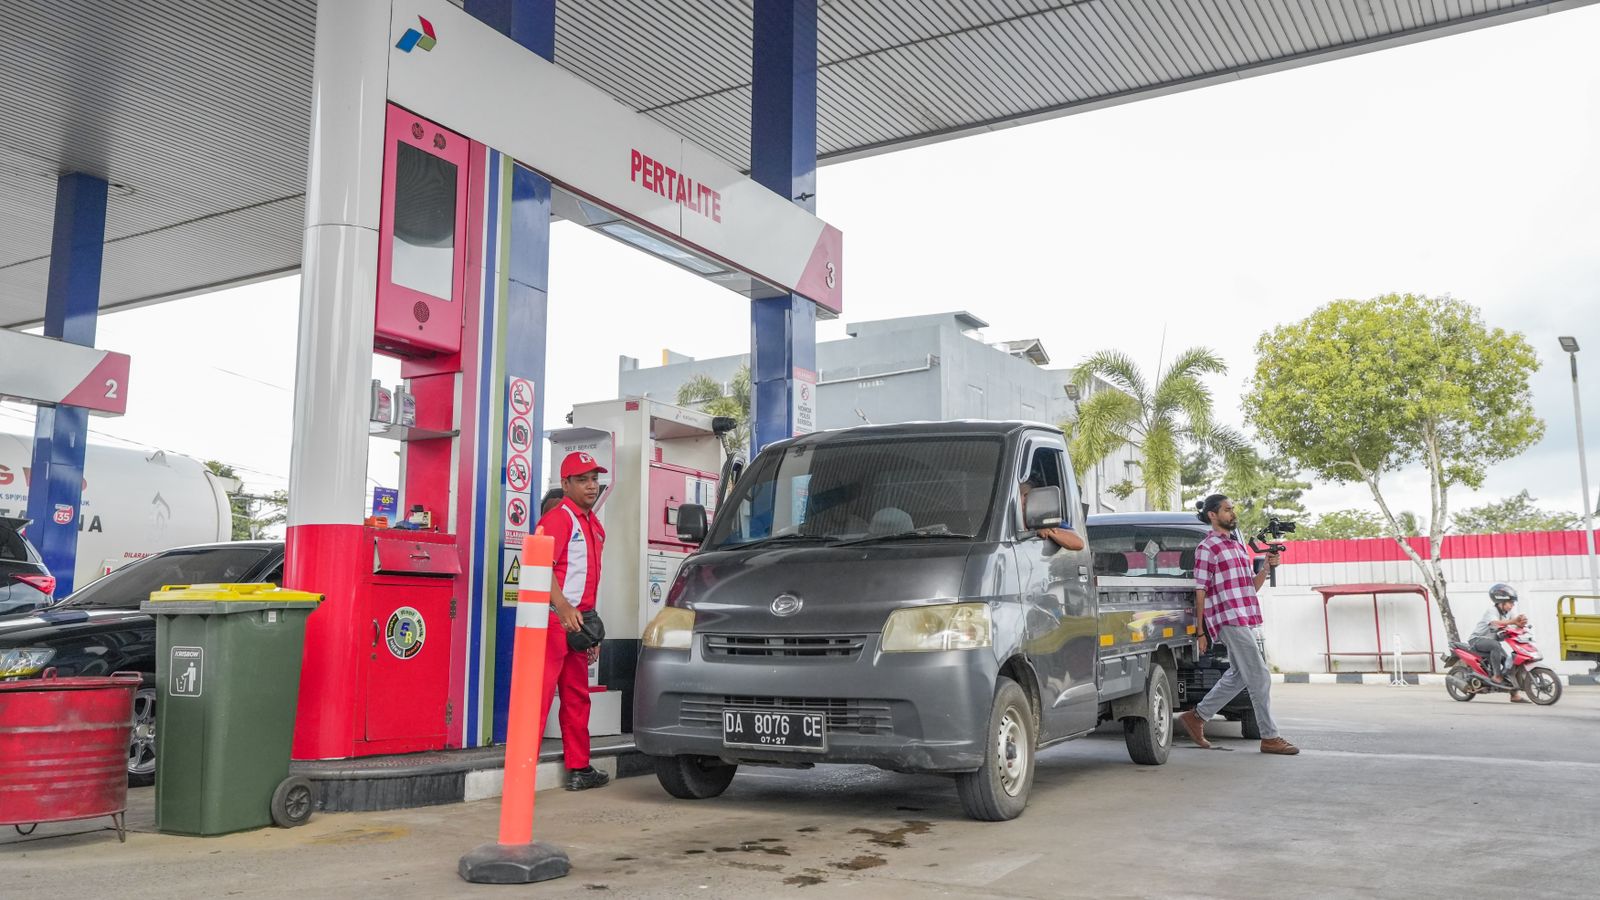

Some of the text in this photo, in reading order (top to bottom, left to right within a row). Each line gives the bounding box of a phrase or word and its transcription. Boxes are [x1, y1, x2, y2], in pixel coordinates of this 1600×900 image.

[631, 148, 721, 224] PERTALITE
[826, 261, 836, 289] 3
[104, 379, 118, 398] 2
[726, 713, 821, 737] DA 8076 CE
